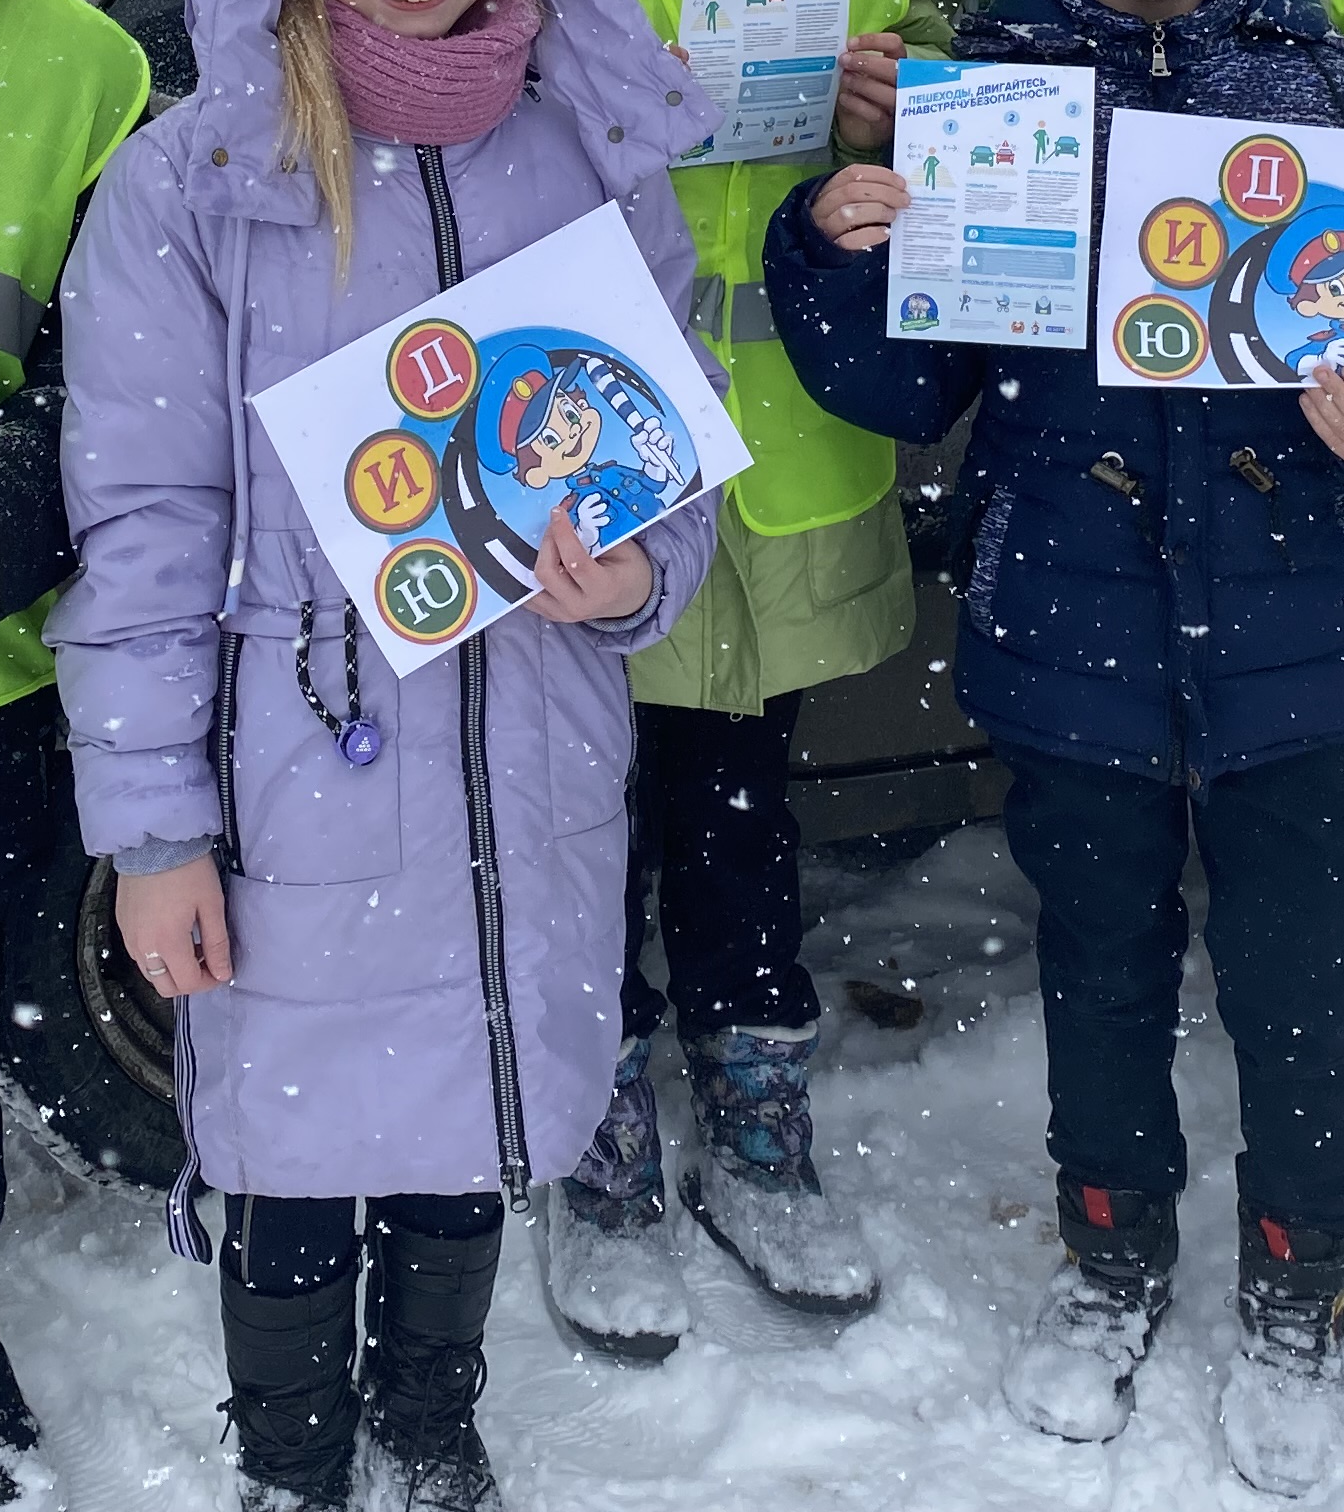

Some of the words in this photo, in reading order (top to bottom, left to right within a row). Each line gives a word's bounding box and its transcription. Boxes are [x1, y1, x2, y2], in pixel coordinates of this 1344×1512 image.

[900, 85, 1060, 117] #НАВСТРЕЧУБЕЗОПАСНОСТИ!
[907, 87, 974, 106] ПЕШЕХОДЫ,
[976, 77, 1047, 97] ДВИГАЙТЕСЬ
[1134, 320, 1191, 359] Ю
[1163, 219, 1207, 267] И
[1241, 154, 1286, 206] Д
[408, 336, 465, 405] Д
[363, 447, 425, 514] И
[393, 563, 460, 627] Ю
